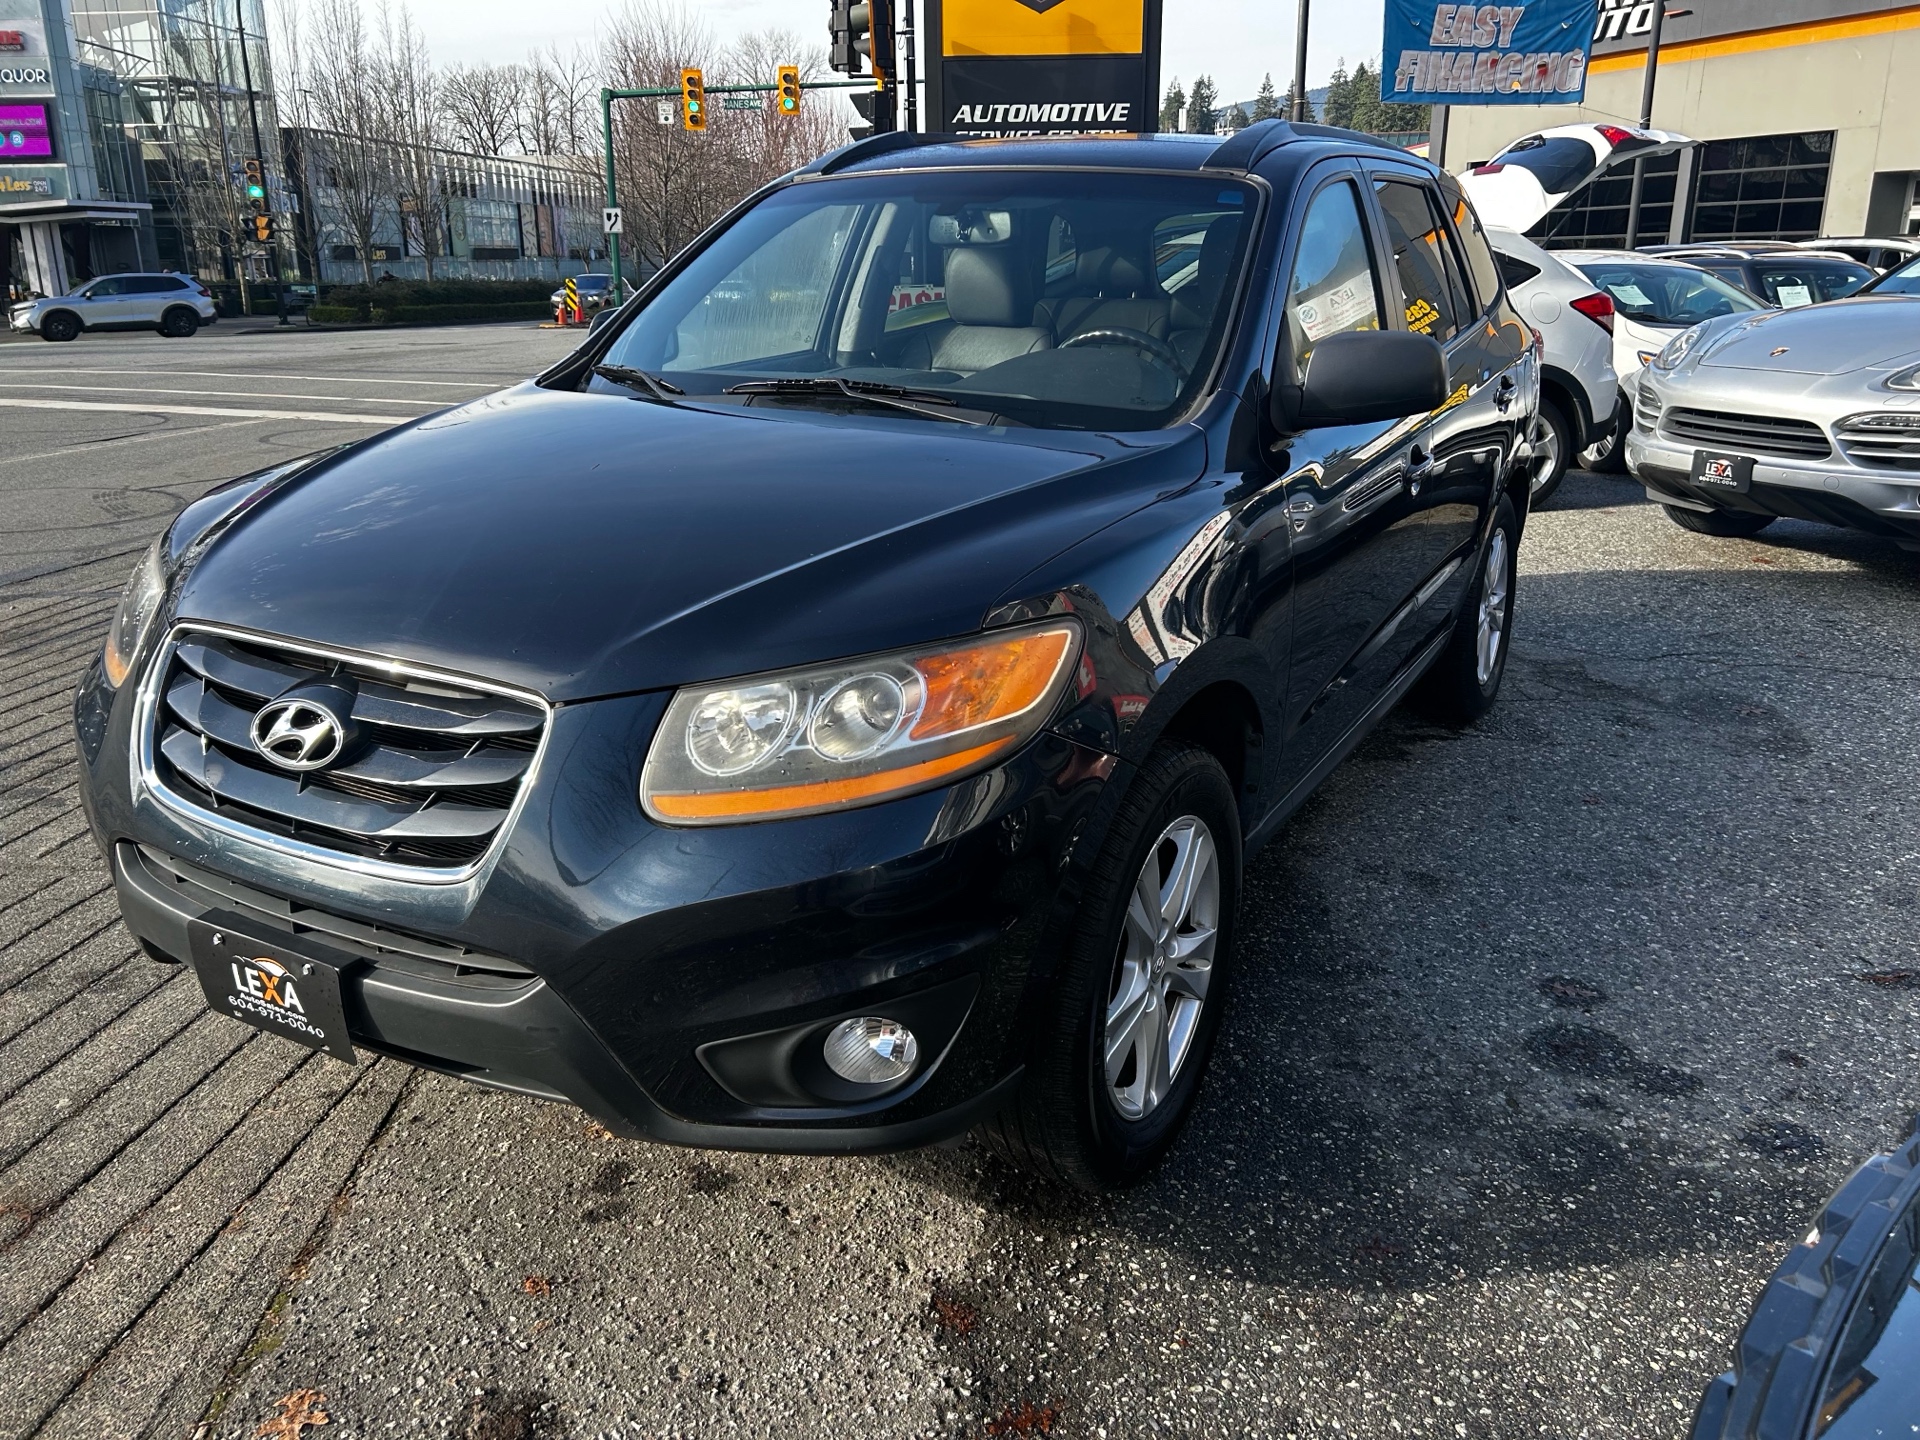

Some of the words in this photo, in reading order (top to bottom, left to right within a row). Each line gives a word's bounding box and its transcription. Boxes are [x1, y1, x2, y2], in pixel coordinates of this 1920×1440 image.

[1430, 3, 1525, 48] EASY
[0, 68, 47, 83] QUOR
[1394, 48, 1585, 94] FINANCING
[723, 100, 750, 109] HANES
[749, 99, 762, 107] AVE
[951, 103, 1131, 124] AUTOMOTIVE
[1705, 462, 1732, 478] LEXA
[231, 962, 305, 1014] LEXA
[228, 995, 325, 1039] 604-971-0040
[240, 992, 308, 1023] AutoSales.com
